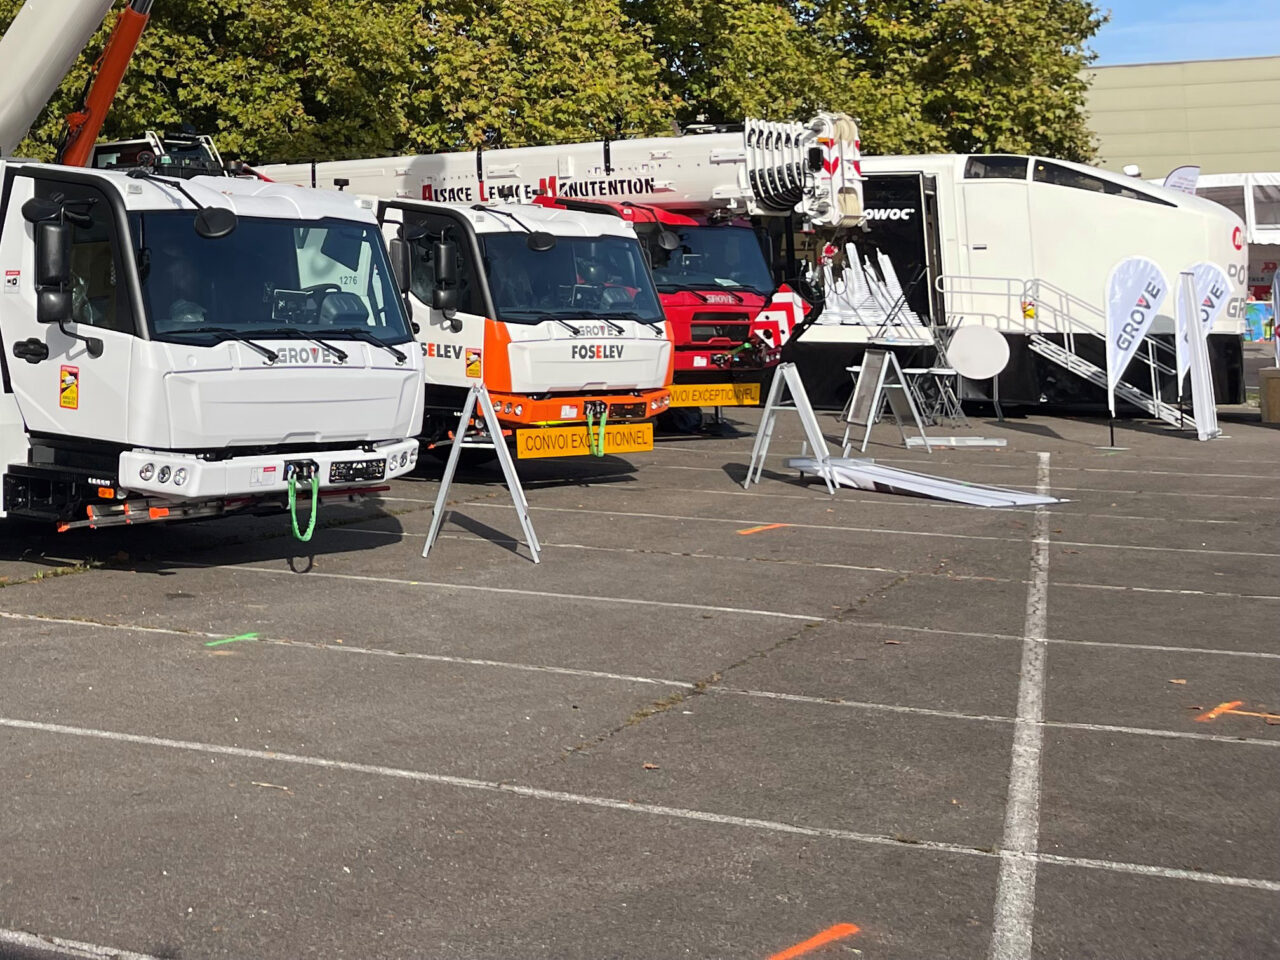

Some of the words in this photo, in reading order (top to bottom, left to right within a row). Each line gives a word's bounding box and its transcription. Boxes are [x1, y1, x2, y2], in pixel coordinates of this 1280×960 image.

[422, 184, 472, 202] ALSACE
[339, 275, 358, 285] 1276
[1116, 281, 1161, 351] GROVE
[579, 325, 614, 336] GROVE
[276, 347, 332, 363] GROVE
[421, 342, 463, 360] SELEV
[571, 344, 624, 359] FOSELEV
[525, 434, 569, 452] CONVOI
[571, 431, 648, 449] EXCETIONNEL
